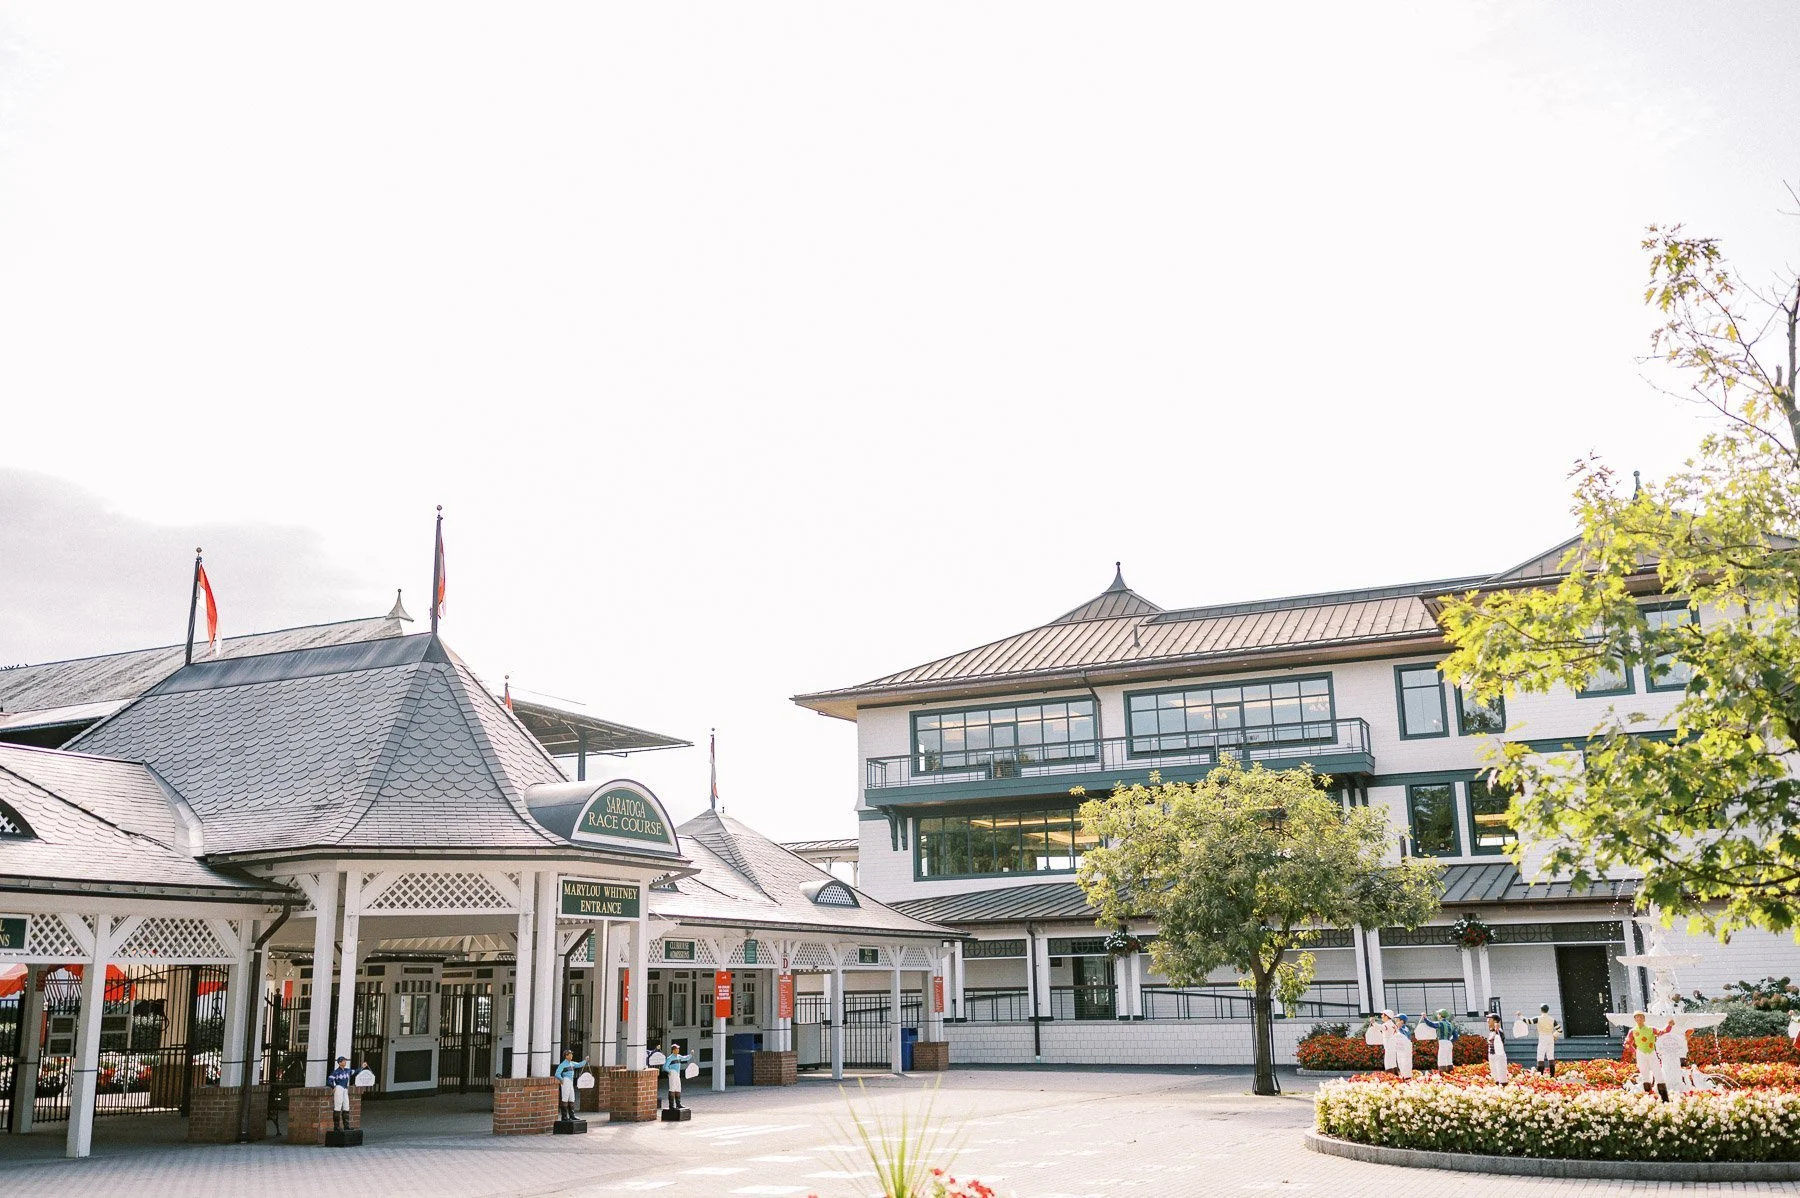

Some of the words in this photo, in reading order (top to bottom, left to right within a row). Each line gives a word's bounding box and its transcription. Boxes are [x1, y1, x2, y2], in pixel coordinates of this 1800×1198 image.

[606, 796, 646, 819] SARATOGA
[588, 811, 619, 830] RACE
[621, 817, 662, 836] COURSE
[564, 883, 600, 897] MARYLOU
[604, 886, 638, 900] WHITNEY
[580, 900, 622, 914] ENTRANCE
